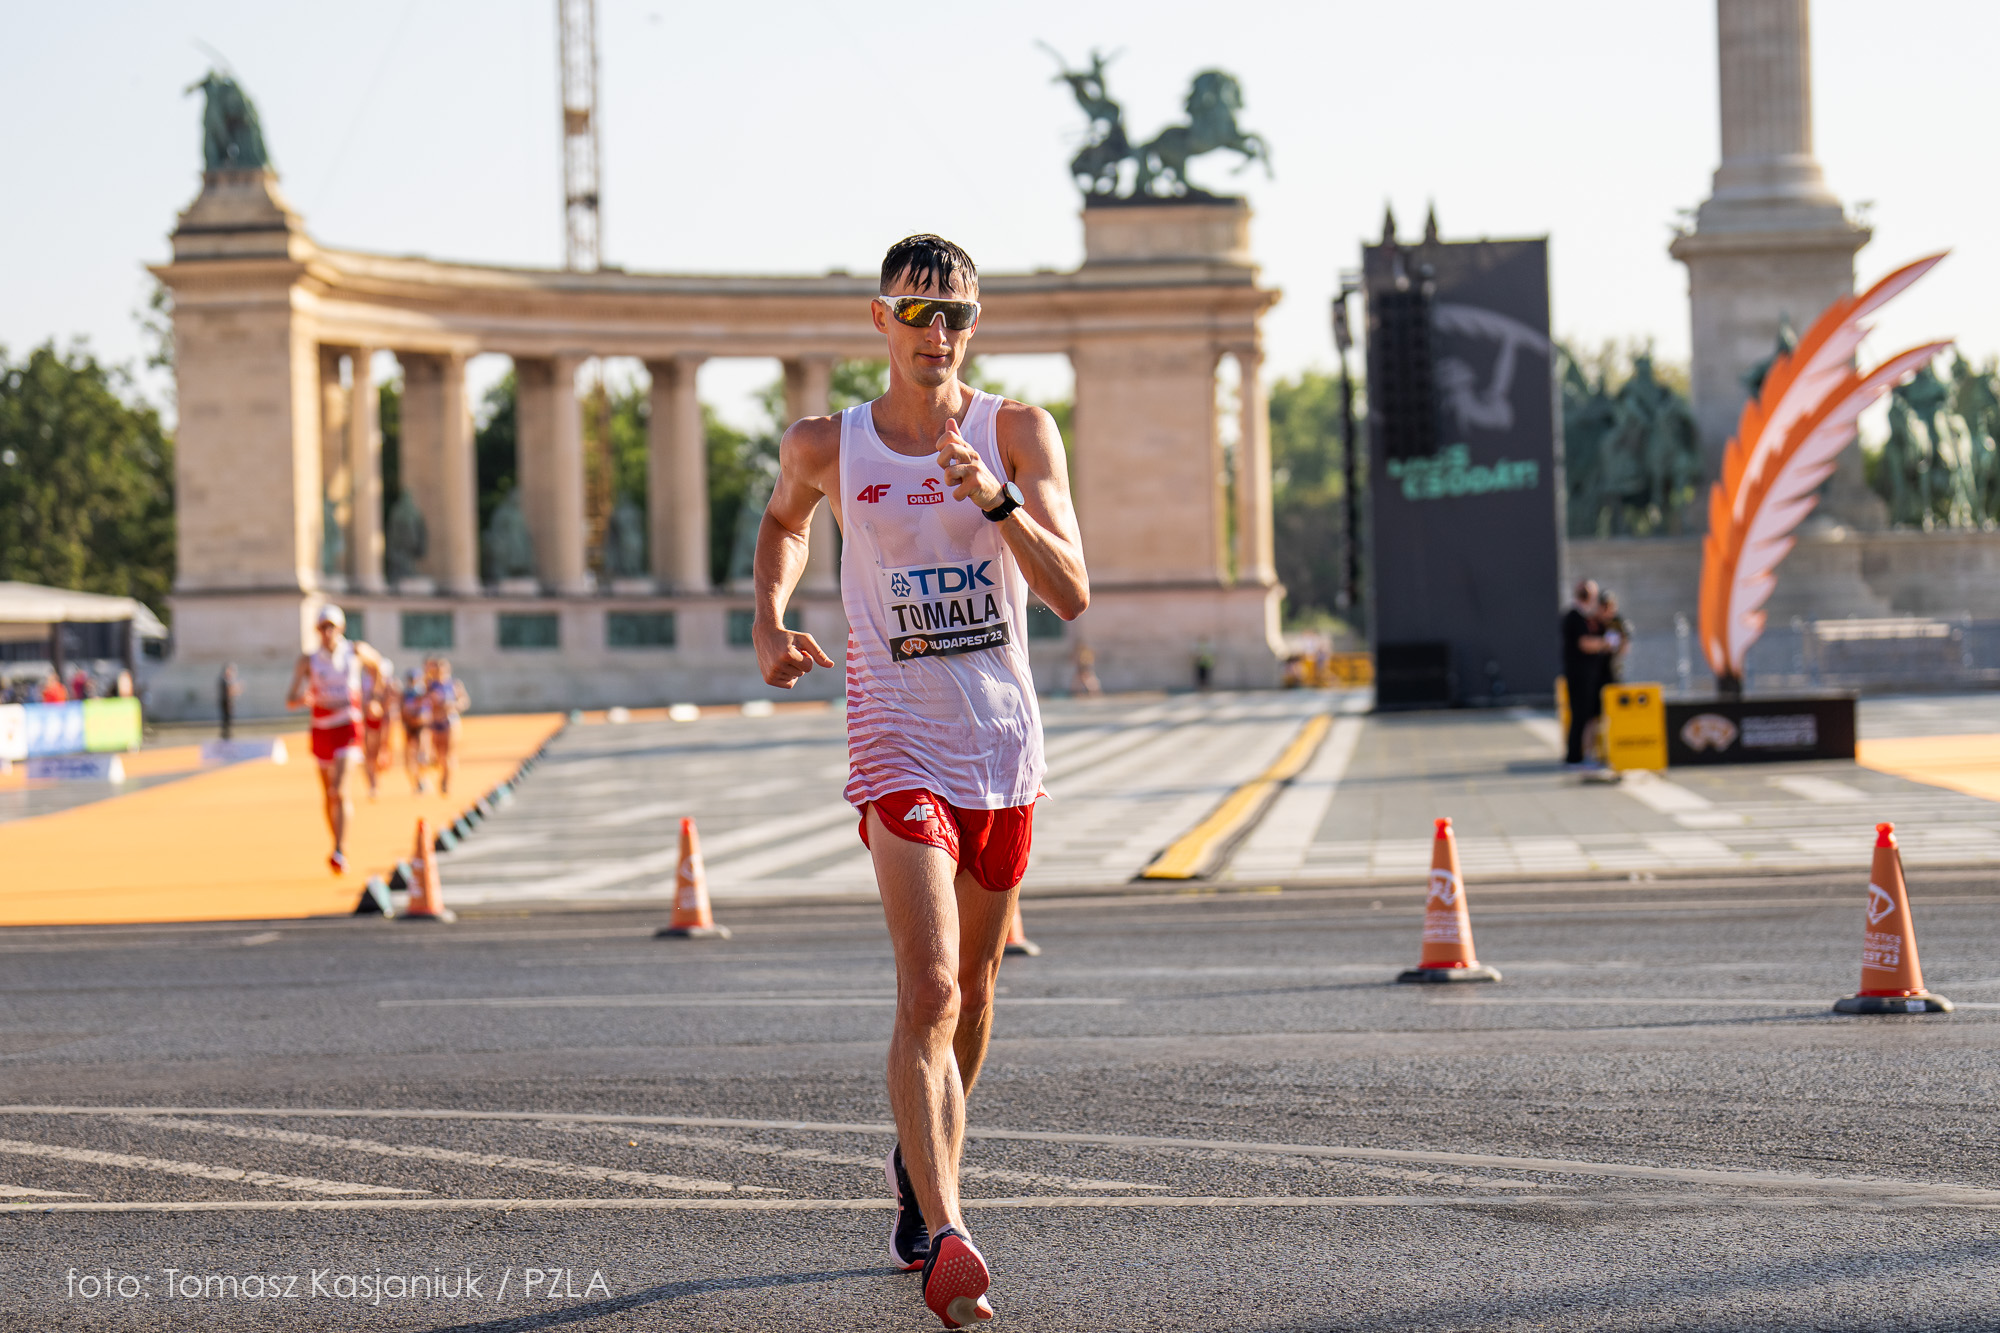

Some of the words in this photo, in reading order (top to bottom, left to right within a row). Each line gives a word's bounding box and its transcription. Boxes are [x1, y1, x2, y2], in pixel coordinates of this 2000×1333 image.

[857, 484, 891, 503] 4F
[909, 493, 943, 504] ORLEN
[908, 560, 995, 595] TDK
[892, 593, 1000, 632] TOMALA
[929, 634, 989, 650] BUDAPEST
[990, 630, 1003, 642] 23
